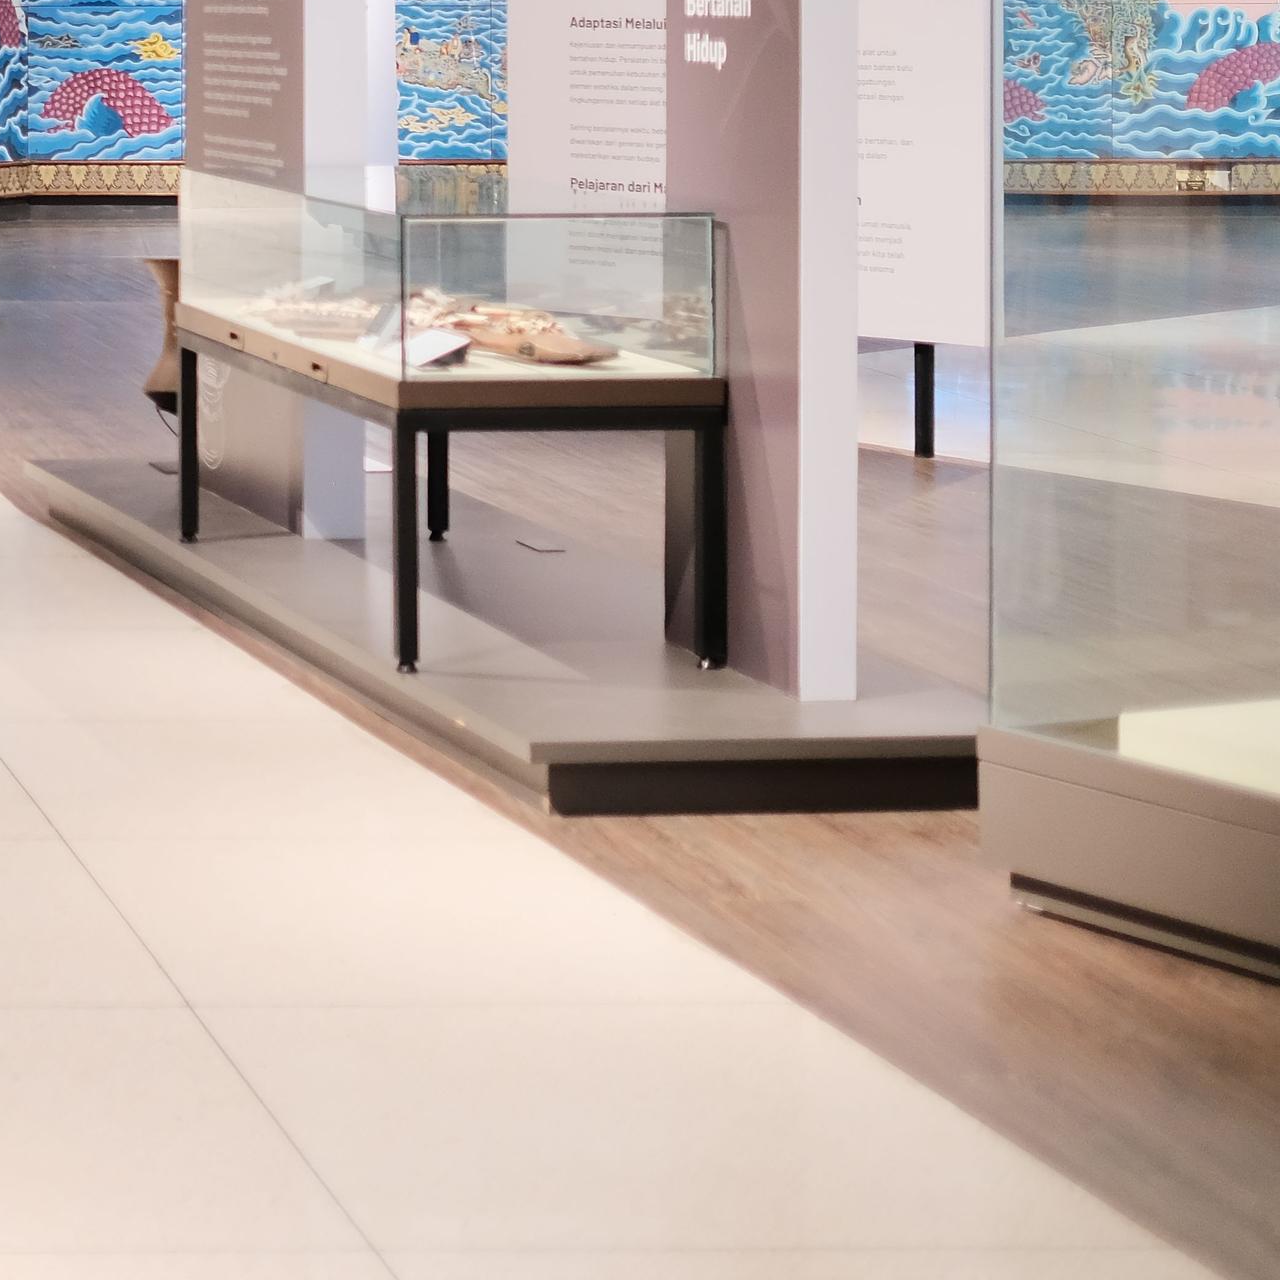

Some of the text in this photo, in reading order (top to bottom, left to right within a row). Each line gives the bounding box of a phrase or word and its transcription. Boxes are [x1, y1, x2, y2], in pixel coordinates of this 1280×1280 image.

[569, 16, 622, 31] Adaptasi
[683, 31, 728, 71] Hidup
[569, 177, 625, 193] Pelajaran
[627, 181, 651, 193] dari
